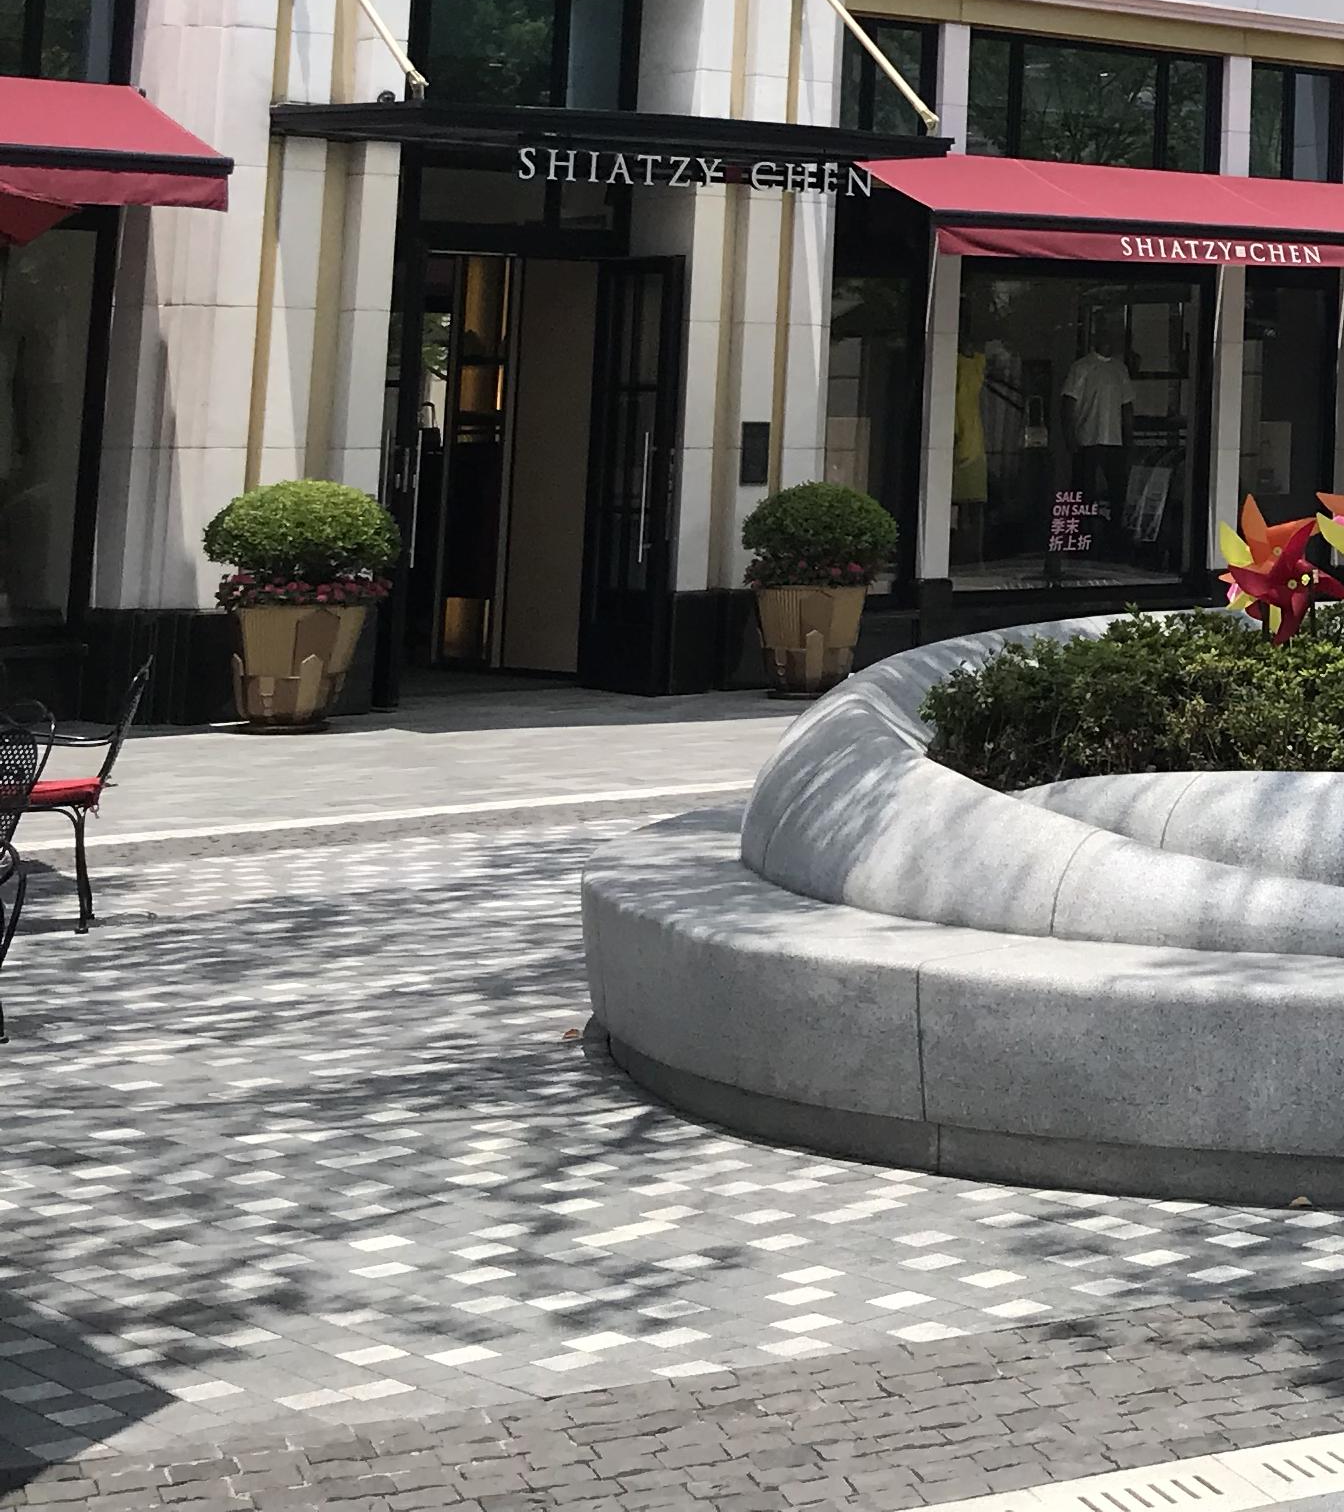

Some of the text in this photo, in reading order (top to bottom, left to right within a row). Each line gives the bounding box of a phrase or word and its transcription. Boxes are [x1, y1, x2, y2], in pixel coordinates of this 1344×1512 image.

[518, 147, 873, 198] SHIATZY CHEN
[1121, 236, 1321, 263] SHIATZY CHEN
[1056, 491, 1083, 502] SALE
[1053, 504, 1098, 516] ON SALE
[1051, 518, 1079, 534] 季末
[1049, 535, 1091, 551] 折上折
